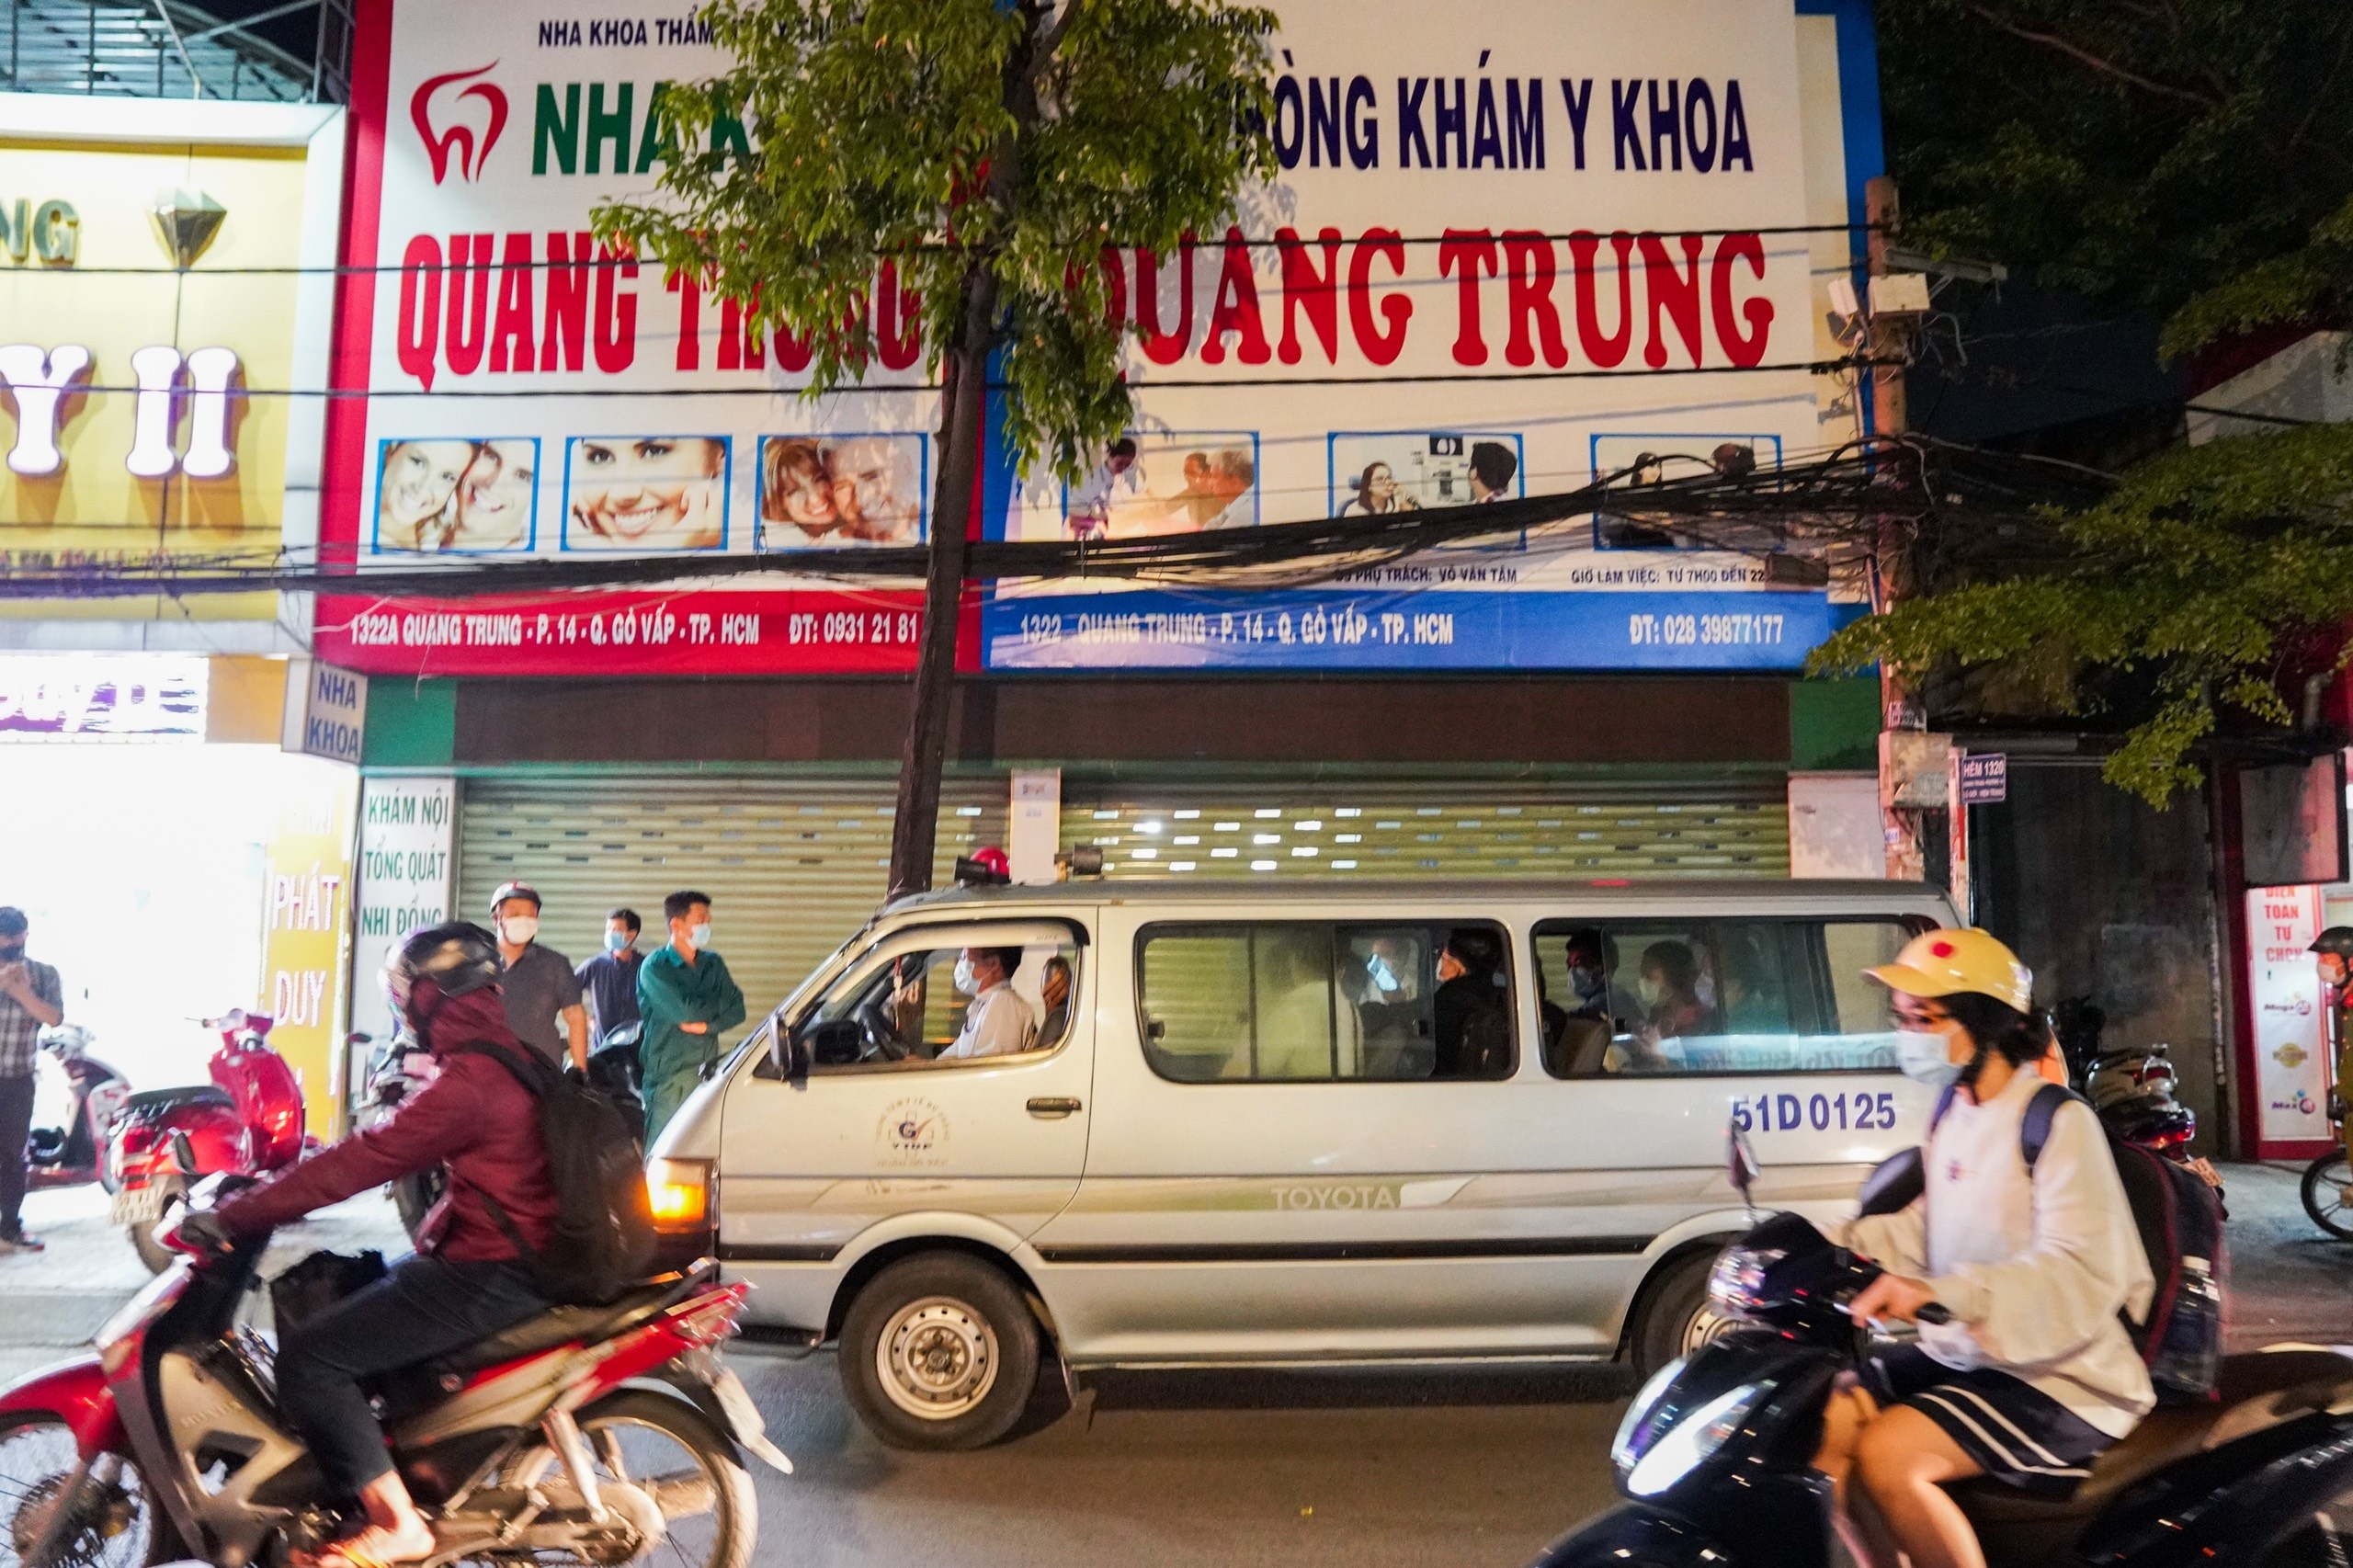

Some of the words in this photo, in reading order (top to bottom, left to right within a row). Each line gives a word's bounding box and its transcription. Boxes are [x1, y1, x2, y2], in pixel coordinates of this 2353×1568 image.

[539, 20, 582, 47] NHA
[589, 18, 648, 46] KHOA
[531, 81, 681, 176] NHA
[1398, 50, 1546, 172] KHÁM
[1562, 78, 1594, 172] Y
[1612, 79, 1755, 173] KHOA
[397, 232, 640, 392] QUANG
[1438, 227, 1775, 369] TRUNG
[1386, 563, 1432, 582] TRÁCH:
[1687, 569, 1718, 583] 7H00
[350, 613, 398, 645] 1322A
[403, 613, 461, 646] QUANG
[465, 613, 522, 645] TRUNG
[537, 613, 552, 645] P.
[558, 613, 576, 644] 14
[590, 613, 608, 646] Q.
[642, 601, 676, 645] VẤP
[688, 613, 715, 644] TP.
[721, 613, 759, 645] HCM
[789, 612, 818, 644] ĐT:
[824, 612, 865, 643] 0931
[871, 612, 891, 643] 21
[897, 612, 917, 643] 81
[1021, 613, 1062, 643] 1322
[1077, 612, 1141, 644] QUANG
[1145, 612, 1206, 644] TRUNG
[1221, 612, 1237, 643] P.
[1243, 613, 1263, 643] 14
[1278, 612, 1296, 645] Q.
[1332, 601, 1368, 644] VẤP
[1381, 613, 1409, 643] TP.
[1414, 613, 1453, 644] HCM
[1630, 614, 1659, 644] ĐT:
[1664, 615, 1696, 644] 028
[1701, 615, 1783, 644] 39877177
[317, 671, 357, 710] NHA
[307, 714, 359, 756] KHOA
[1984, 759, 2004, 777] 1320
[368, 787, 416, 825] KHÁM
[422, 788, 449, 831] NỘI
[365, 834, 404, 881] TỔNG
[408, 843, 447, 885] QUÁT
[271, 858, 340, 931] PHÁT
[362, 906, 390, 936] NHI
[274, 970, 327, 1028] DUY
[1270, 1186, 1396, 1210] TOYOTA
